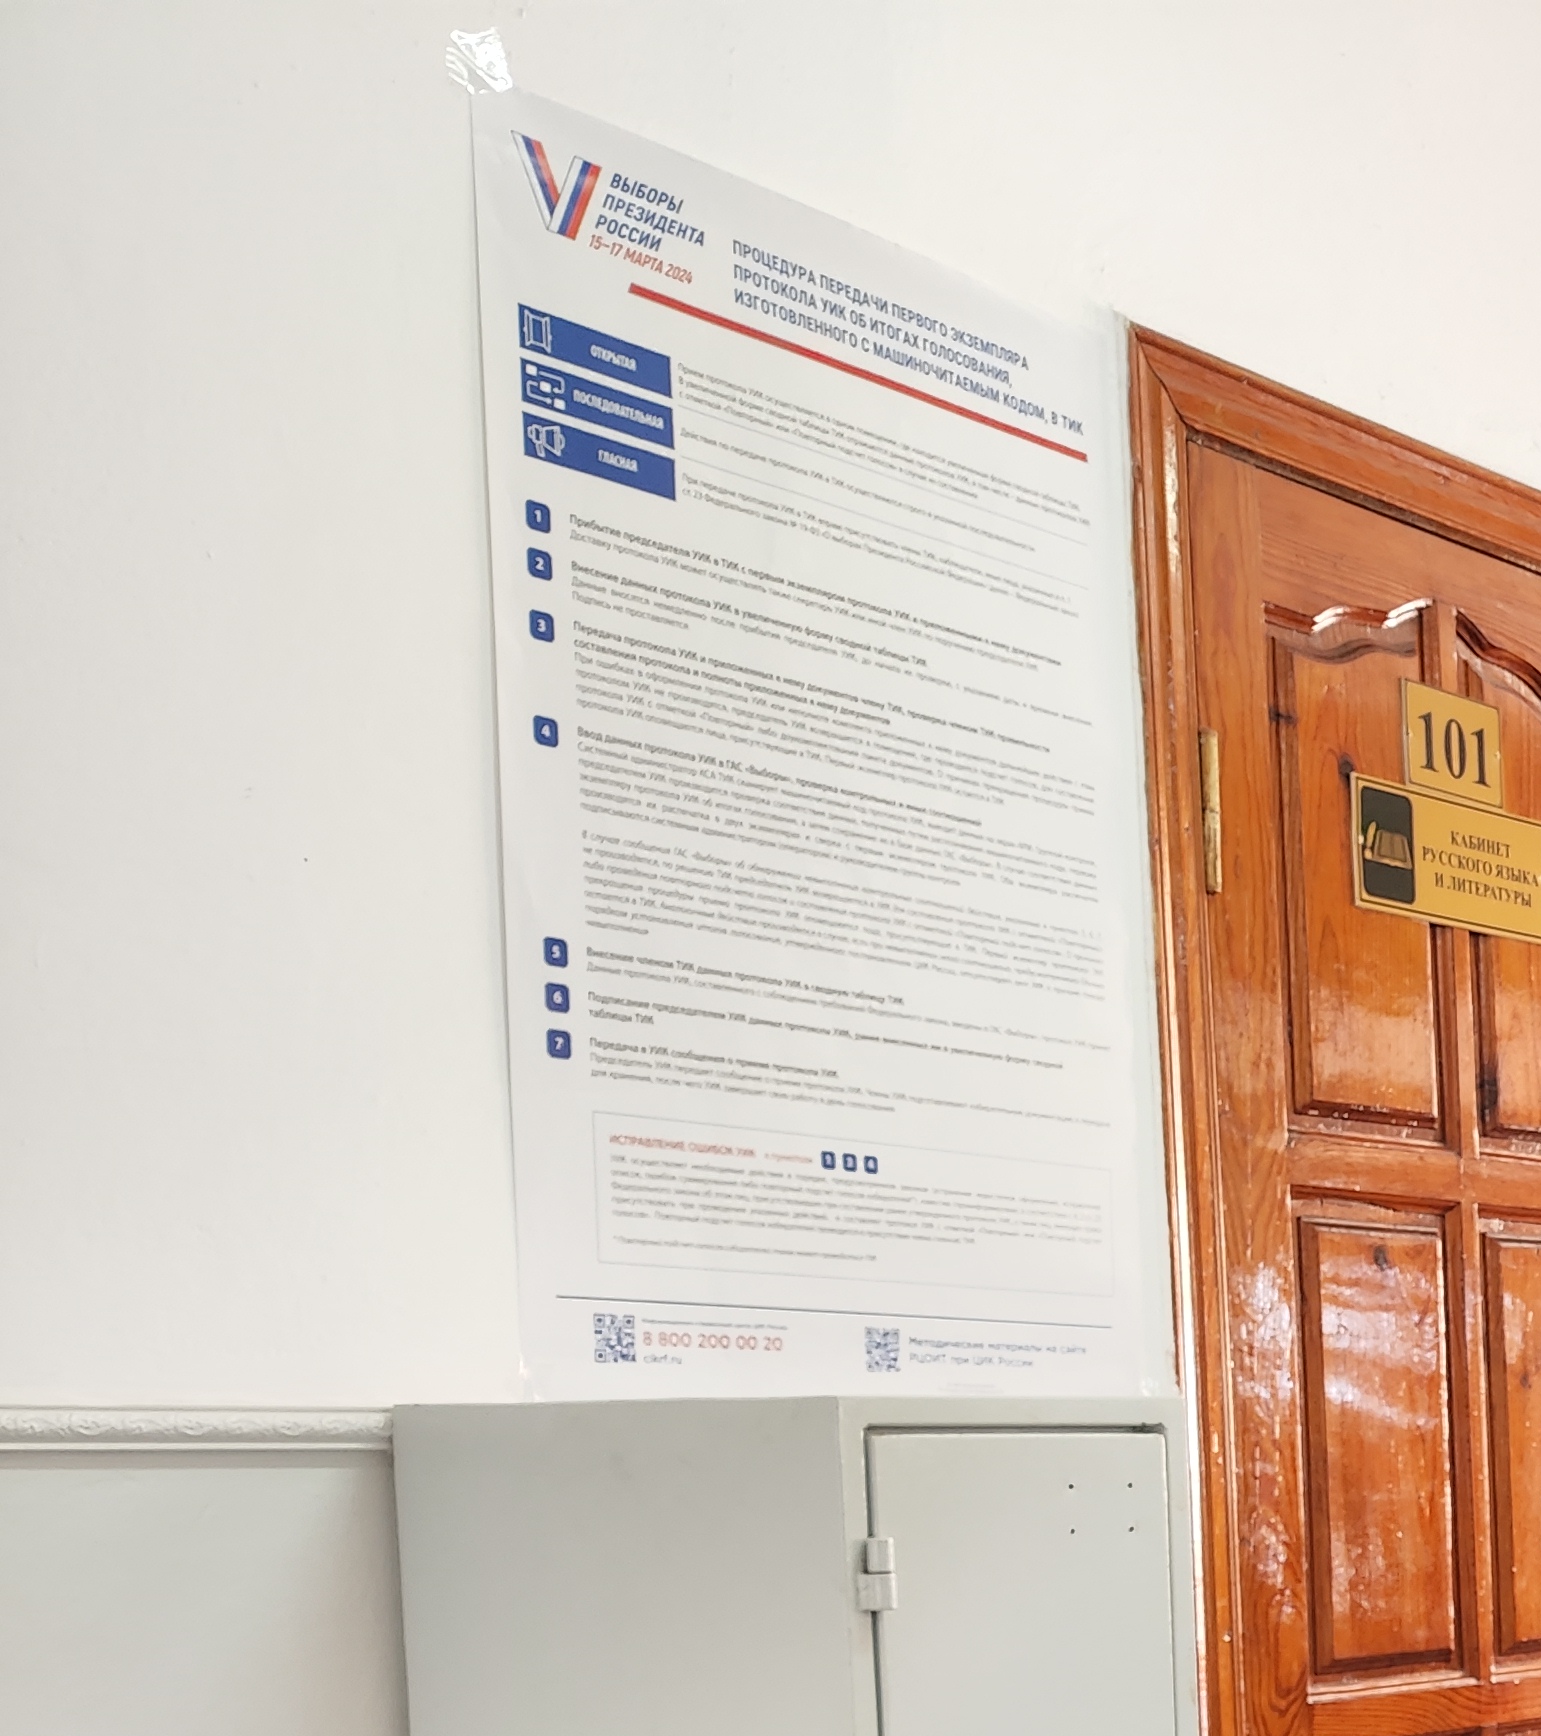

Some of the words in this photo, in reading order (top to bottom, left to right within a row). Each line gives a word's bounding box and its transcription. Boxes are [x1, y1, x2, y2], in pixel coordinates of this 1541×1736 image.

[610, 173, 684, 214] ВЫБОРЫ
[595, 214, 662, 252] РОССИИ
[602, 194, 705, 246] ПРЕЗИДЕНТА
[624, 247, 664, 274] МАРТА
[665, 263, 693, 284] 2024
[732, 240, 815, 283] ПРОЦЕДУРА
[819, 274, 888, 313] ПЕРЕДАЧИ
[891, 303, 947, 336] ПЕРВОГО
[951, 327, 1027, 369] ЭКЗЕМПЛЯРА
[733, 264, 816, 308] ПРОТОКОЛА
[821, 298, 846, 320] УИК
[849, 309, 866, 328] ОБ
[869, 317, 918, 348] ИТОГАХ
[590, 344, 637, 371] ОТКРЫТАЯ
[734, 290, 857, 346] ИЗГОТОВЛЕННОГО
[860, 336, 869, 352] С
[873, 343, 999, 400] МАШИНОЧИТАЕМЫМ
[1050, 410, 1058, 425] В
[1062, 415, 1083, 435] ТИК
[572, 389, 664, 429] ПОСЛЕДОВАТЕЛЬНАЯ
[598, 449, 638, 472] ГЛАСНАЯ
[569, 514, 621, 537] Прибытие
[623, 532, 690, 557] председателя
[570, 560, 618, 582] Внесение
[620, 576, 657, 593] данных
[572, 621, 622, 642] Передача
[623, 636, 676, 656] протокола
[573, 639, 636, 660] составления
[576, 726, 603, 742] Ввод
[1418, 712, 1491, 788] 101
[1450, 830, 1510, 858] КАБИНЕТ
[1422, 846, 1493, 877] РУССКОГО
[1495, 864, 1539, 887] ЯЗЫКА
[1434, 872, 1445, 887] И
[1447, 876, 1532, 907] ЛИТЕРАТУРЫ
[642, 1330, 653, 1346] 8
[657, 1331, 692, 1347] 800
[698, 1333, 731, 1349] 200
[735, 1334, 758, 1350] 00
[763, 1335, 782, 1351] 20
